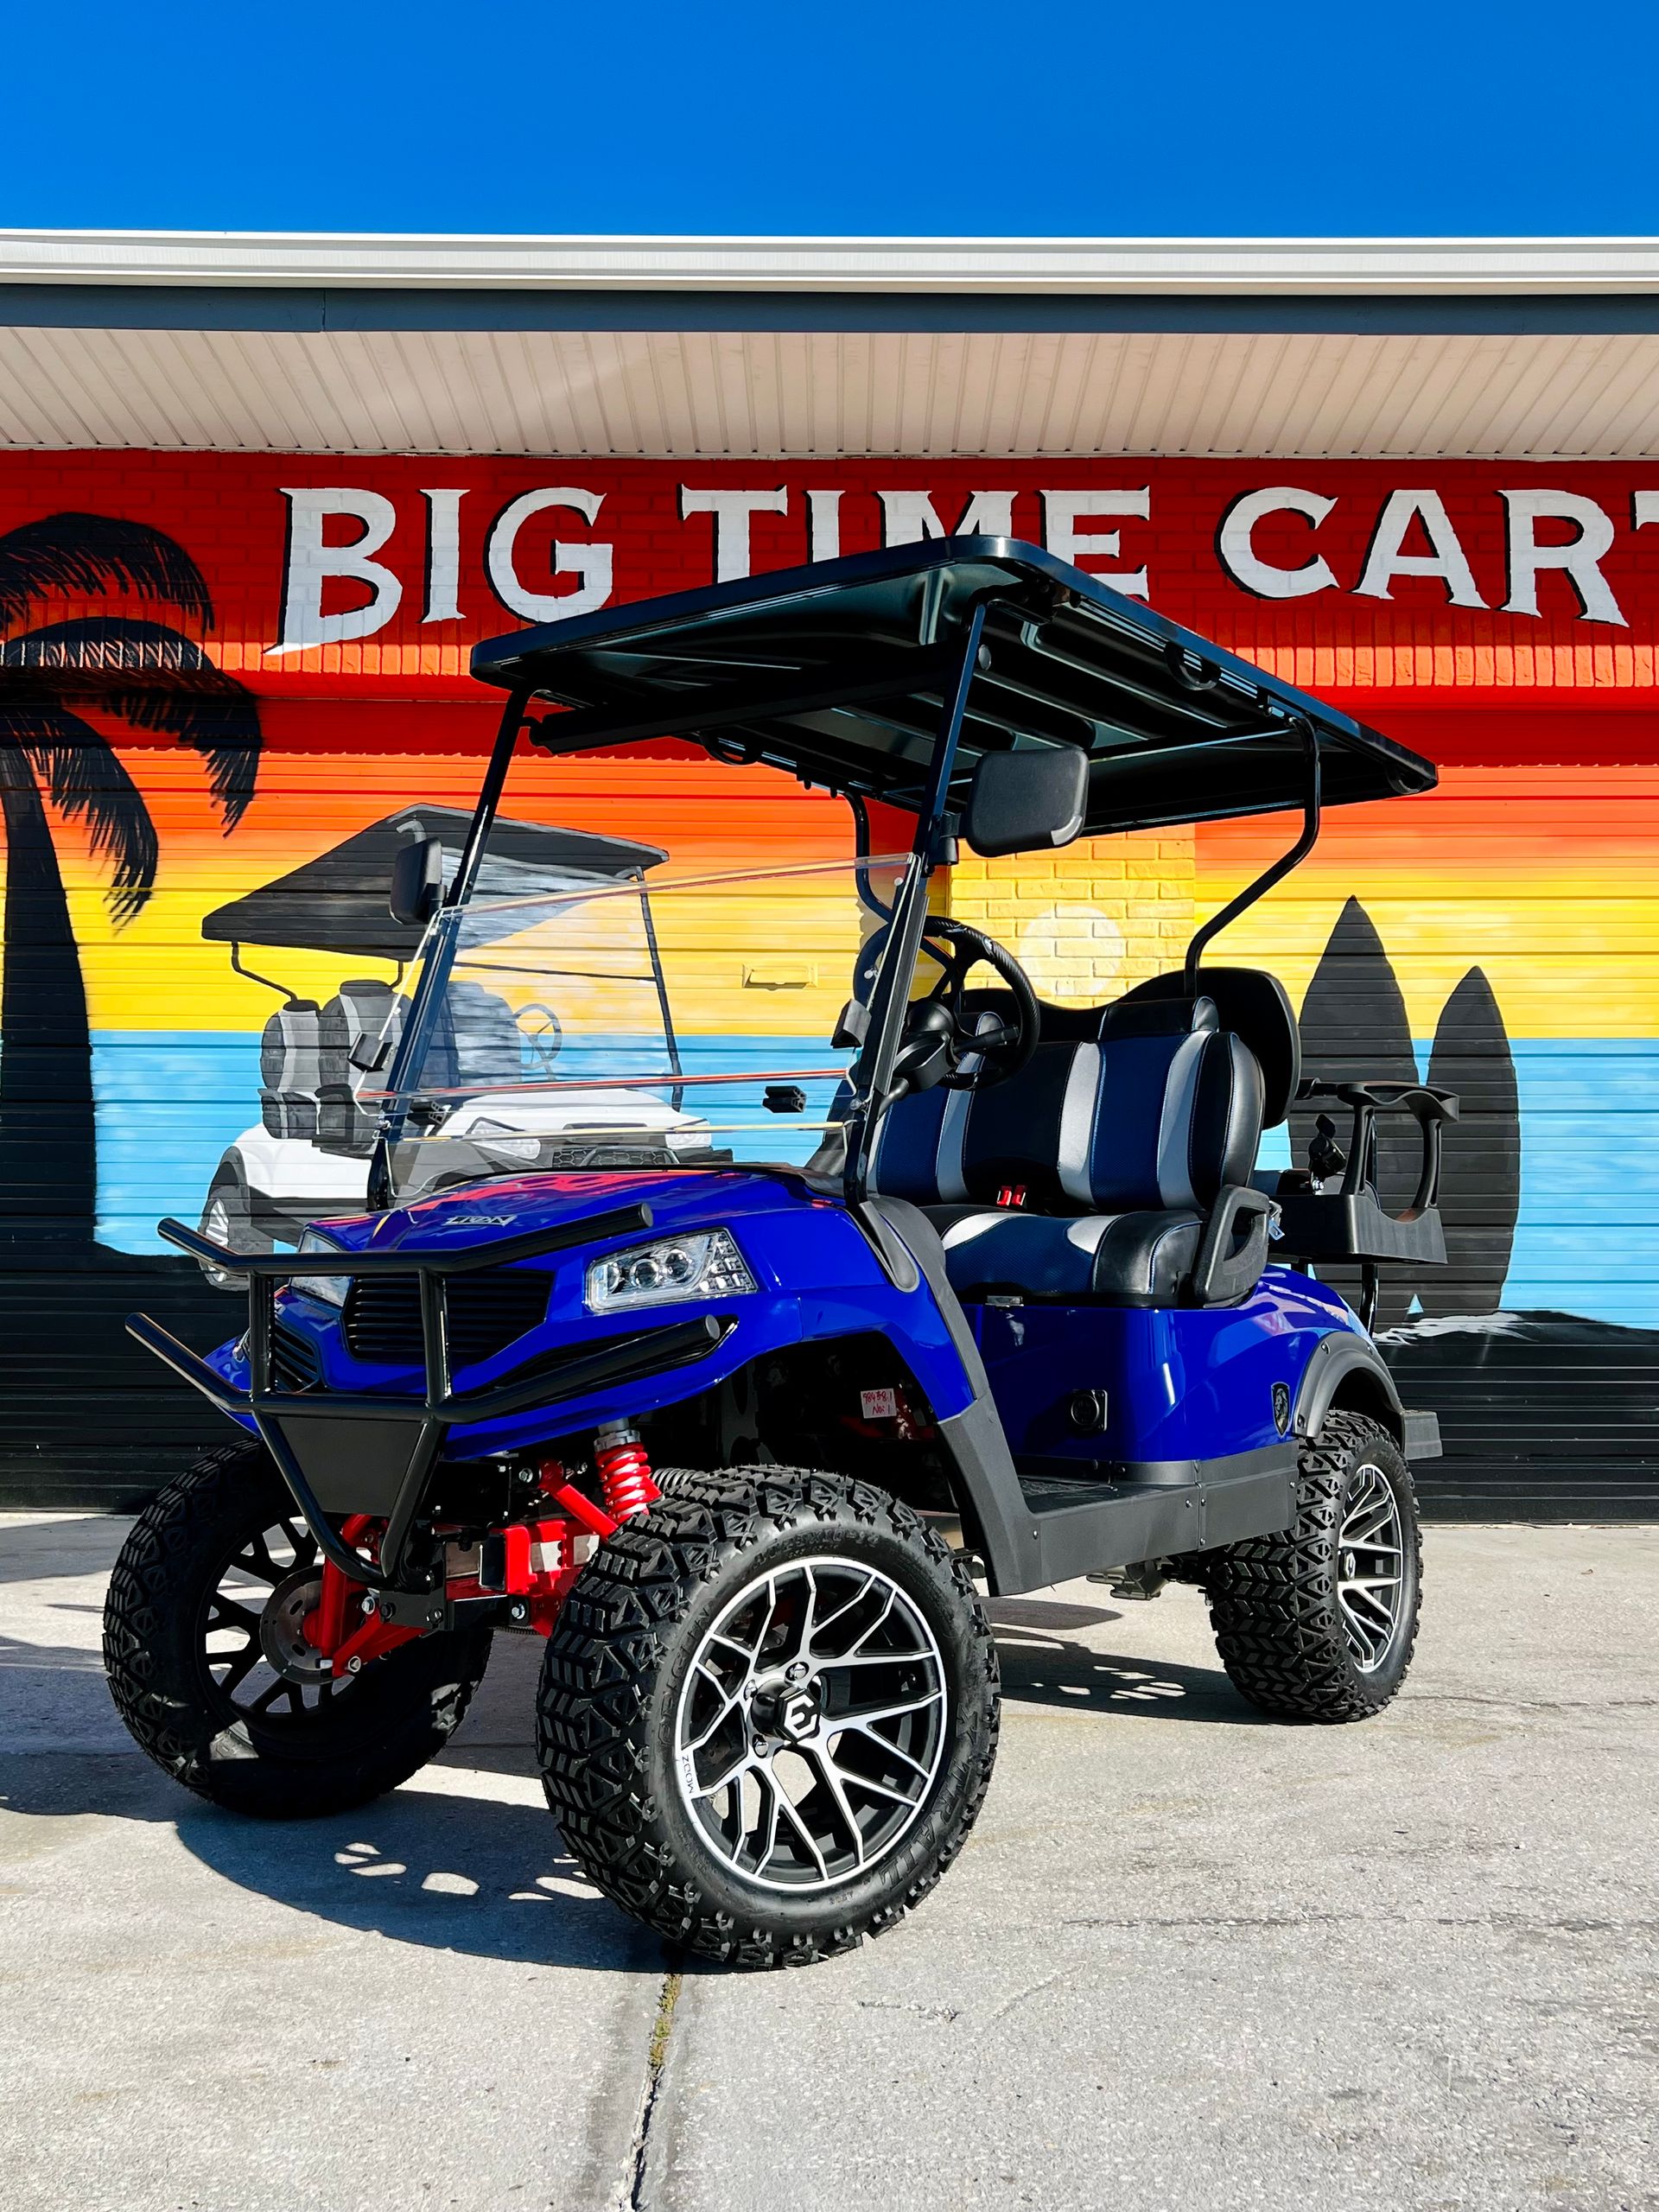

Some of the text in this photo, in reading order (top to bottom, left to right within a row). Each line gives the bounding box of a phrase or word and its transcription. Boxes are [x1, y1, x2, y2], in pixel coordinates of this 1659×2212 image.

[262, 486, 613, 656] BIG
[1214, 486, 1659, 628] CAR
[876, 1756, 972, 1896] TRAIL
